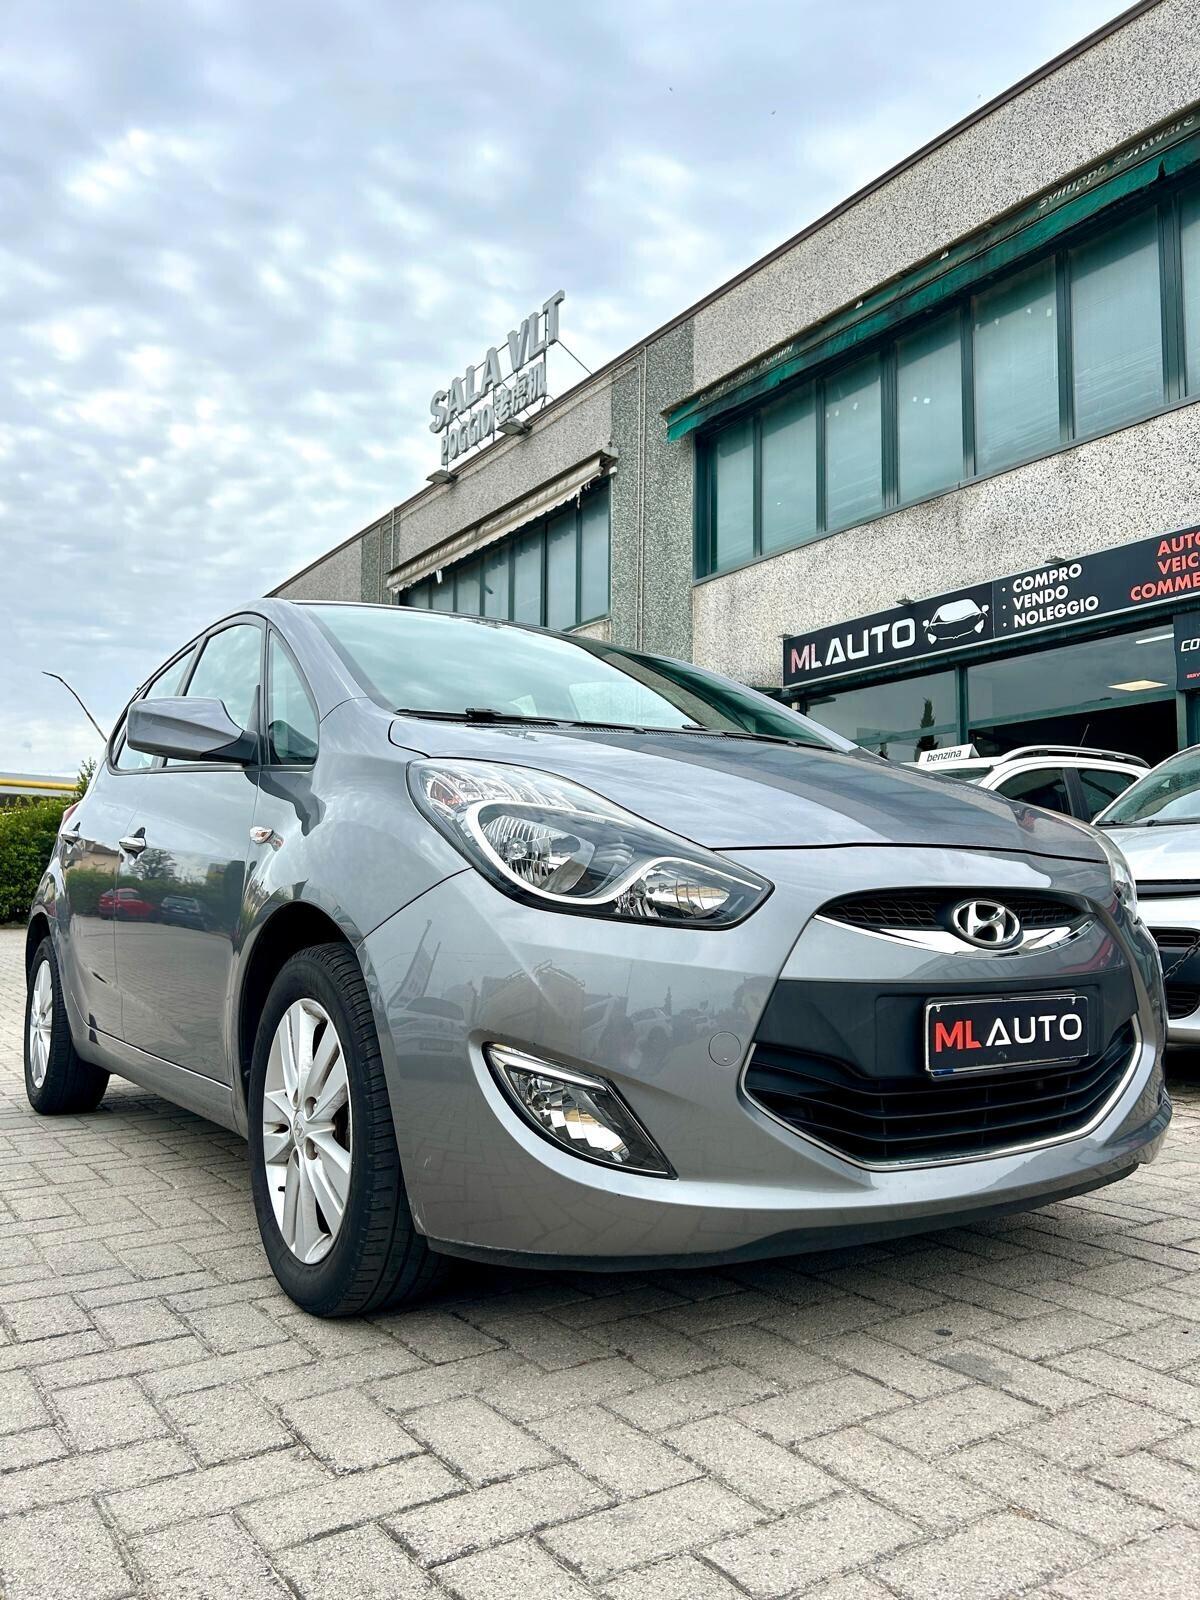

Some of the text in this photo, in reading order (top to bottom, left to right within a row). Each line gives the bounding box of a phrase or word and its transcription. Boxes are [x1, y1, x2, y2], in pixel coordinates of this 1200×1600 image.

[429, 289, 566, 434] SALA VLT
[440, 403, 495, 466] POGGIO
[1012, 563, 1082, 593] COMPRO
[1130, 571, 1200, 601] COMME
[1012, 585, 1069, 610] VENDO
[1013, 596, 1099, 628] NOLEGGIO
[926, 749, 962, 763] benzina
